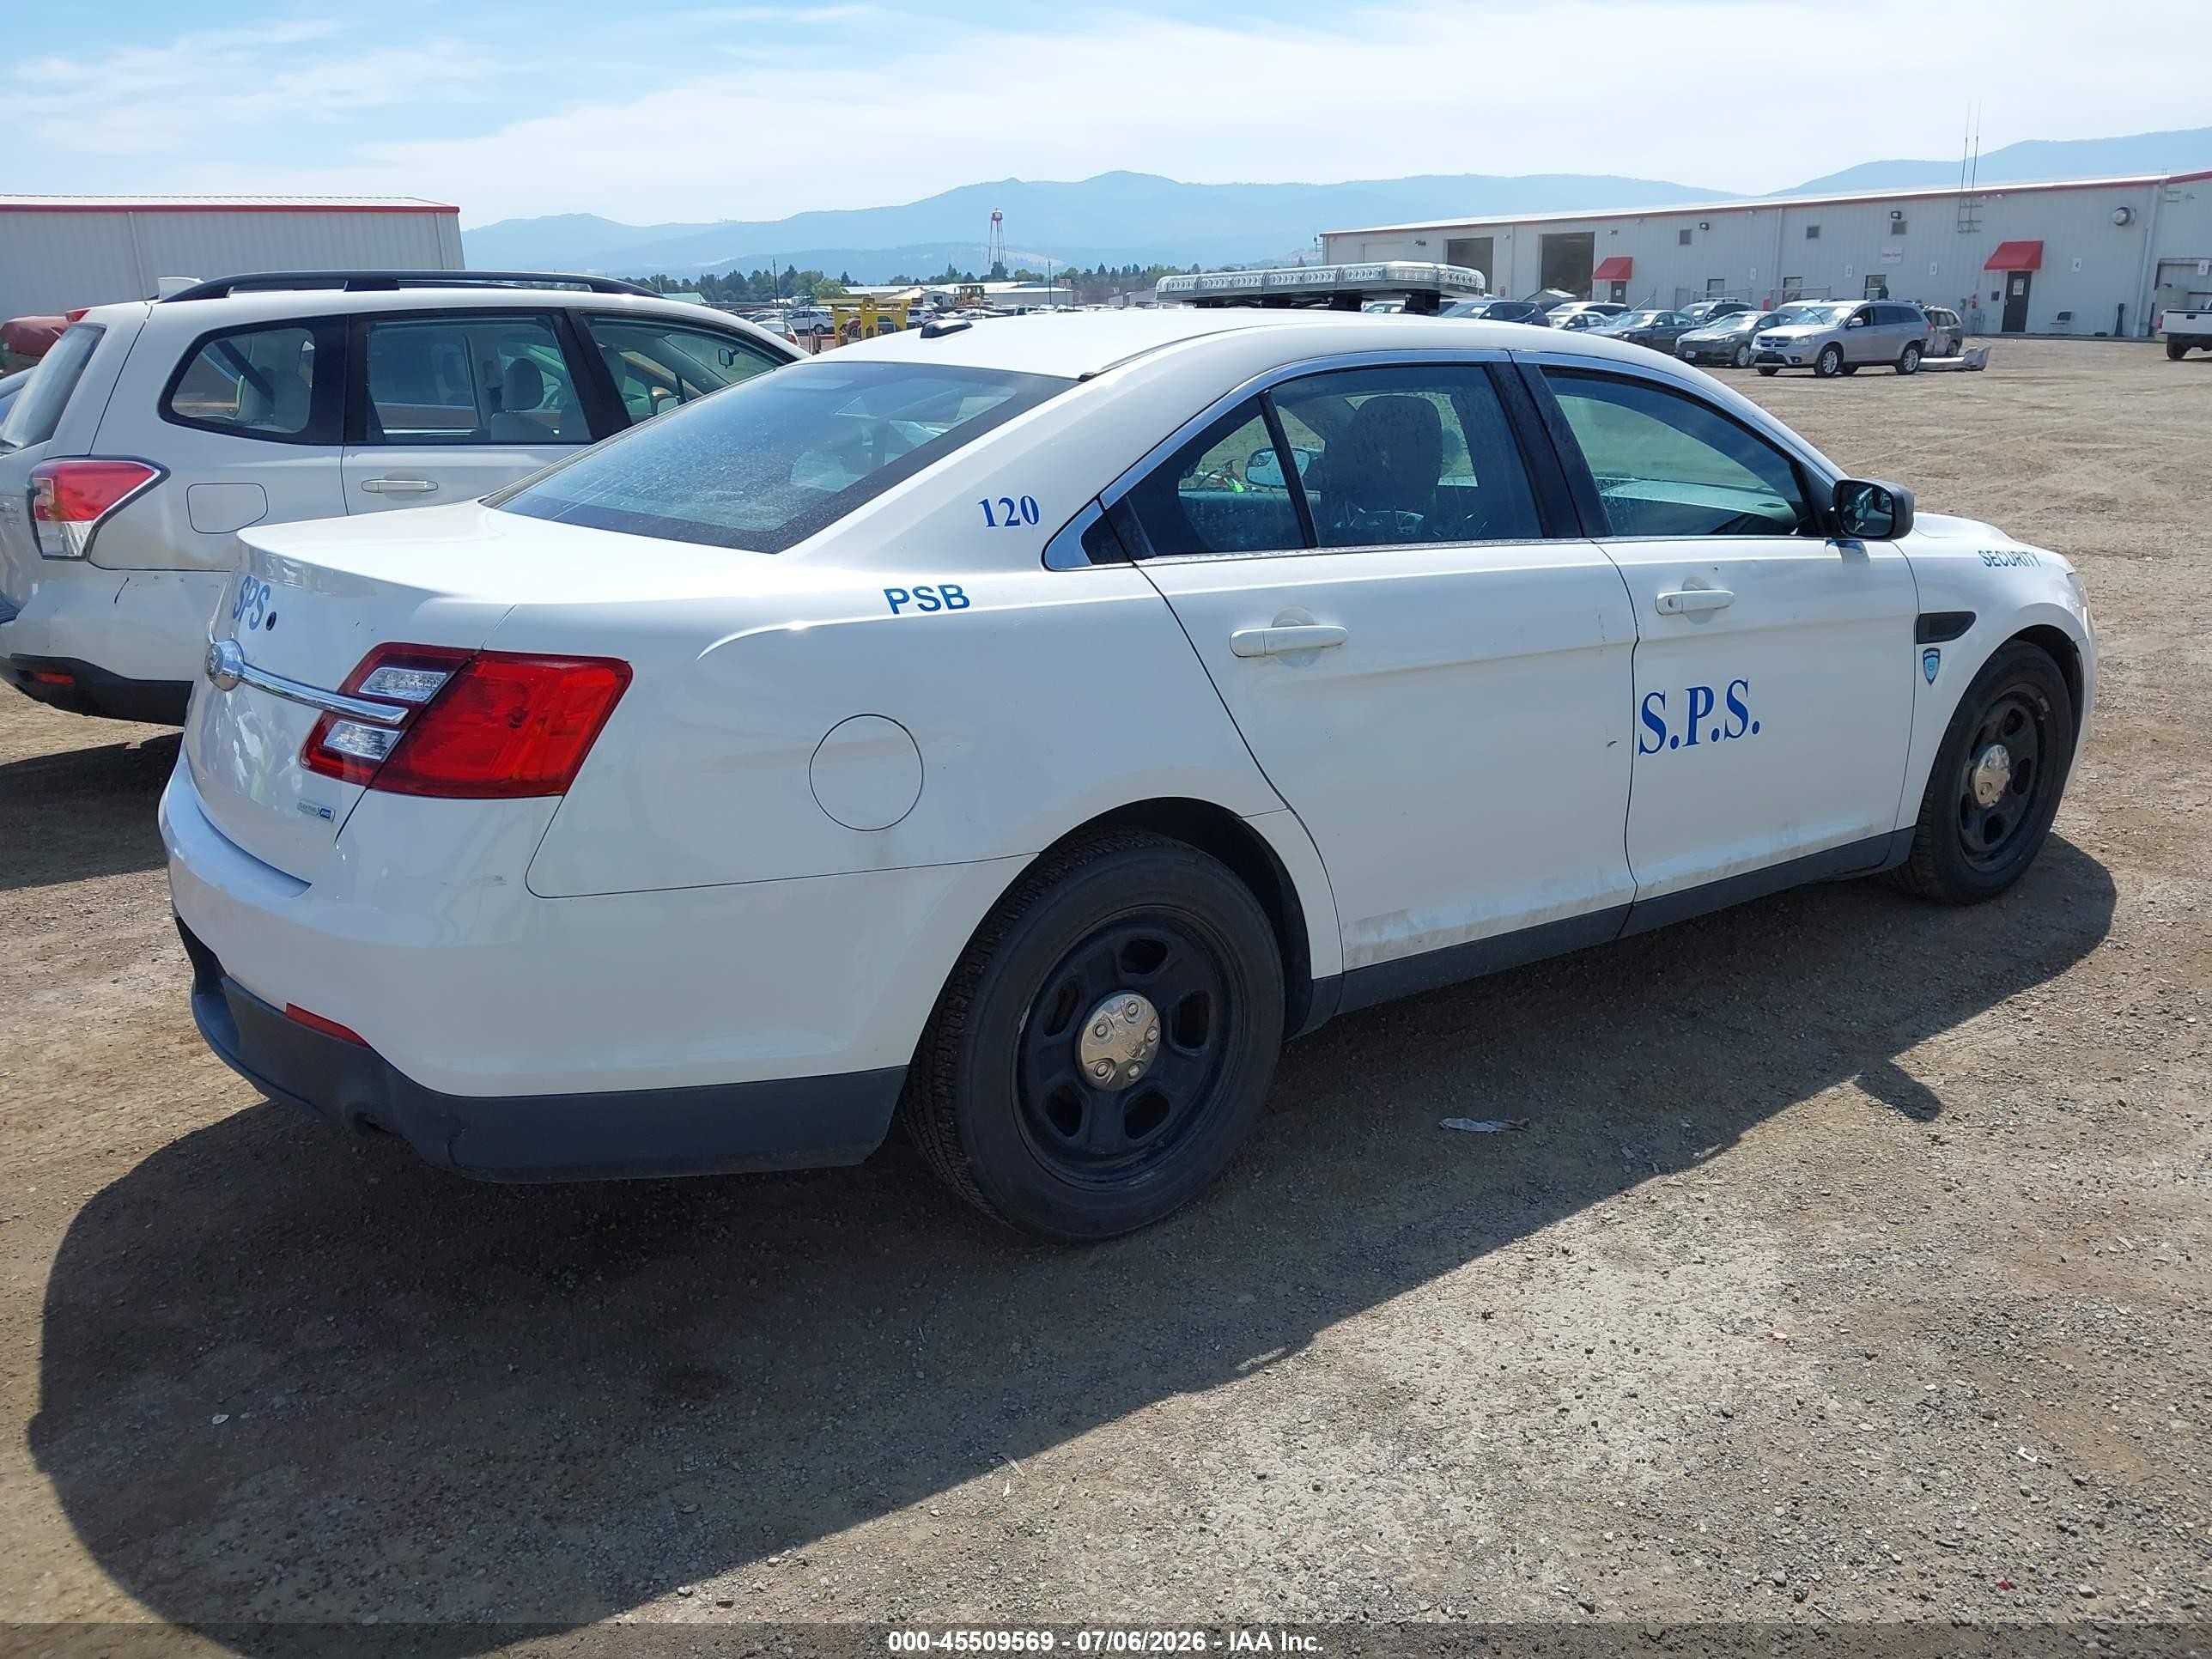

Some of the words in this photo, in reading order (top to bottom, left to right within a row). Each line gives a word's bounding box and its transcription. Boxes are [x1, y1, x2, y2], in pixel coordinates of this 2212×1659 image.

[977, 495, 1041, 528] 120
[1978, 550, 2041, 568] SECURITY
[232, 574, 271, 631] SPS
[884, 584, 970, 615] PSB
[1638, 678, 1761, 756] S.P.S.
